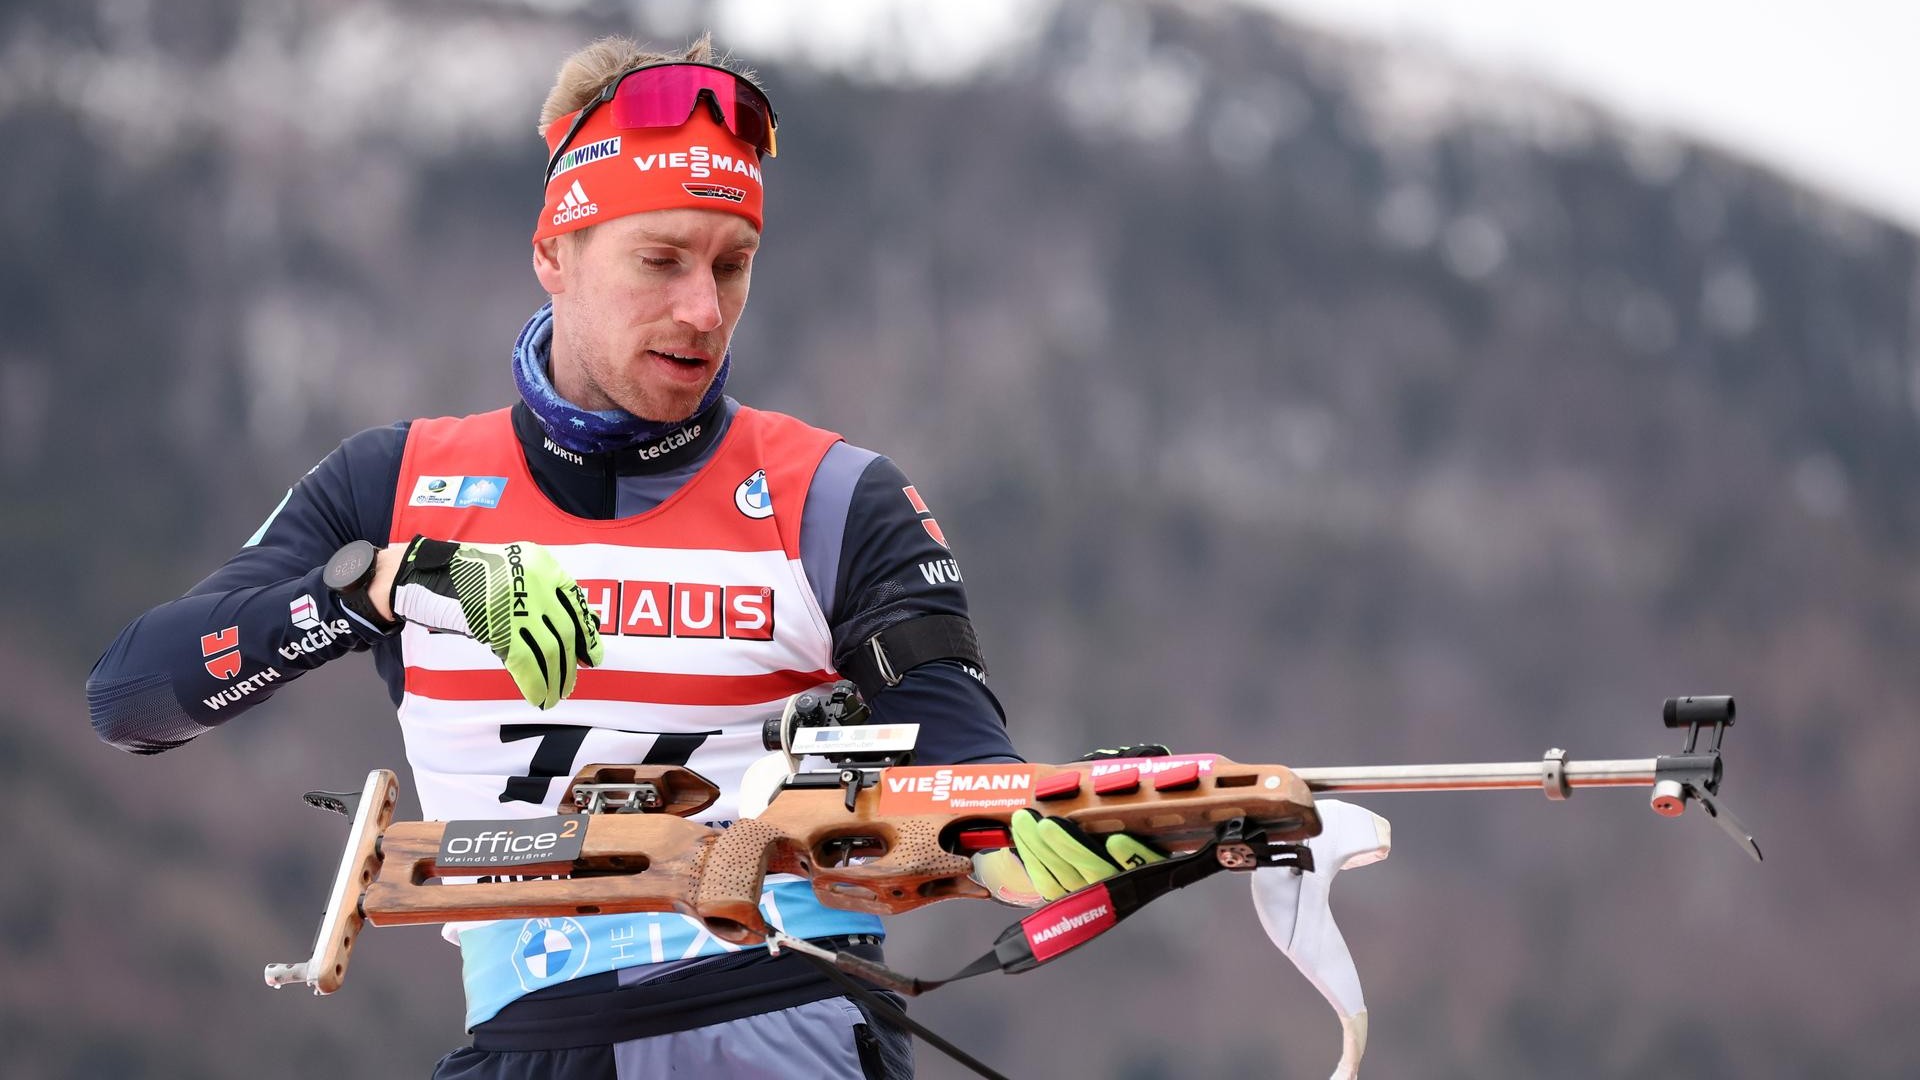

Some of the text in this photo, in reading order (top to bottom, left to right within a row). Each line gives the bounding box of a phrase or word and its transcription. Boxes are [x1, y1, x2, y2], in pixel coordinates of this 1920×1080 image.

[553, 203, 598, 225] adidas
[639, 424, 701, 461] tectake
[278, 618, 352, 661] tectake
[203, 667, 281, 711] WÜRTH
[888, 769, 1031, 801] VIESSMANN
[951, 798, 1027, 808] Wärmepumpen
[444, 852, 554, 863] Weindl & Fleißner
[521, 918, 577, 945] BMW
[1032, 904, 1108, 945] HANDWERK
[611, 925, 635, 970] HE
